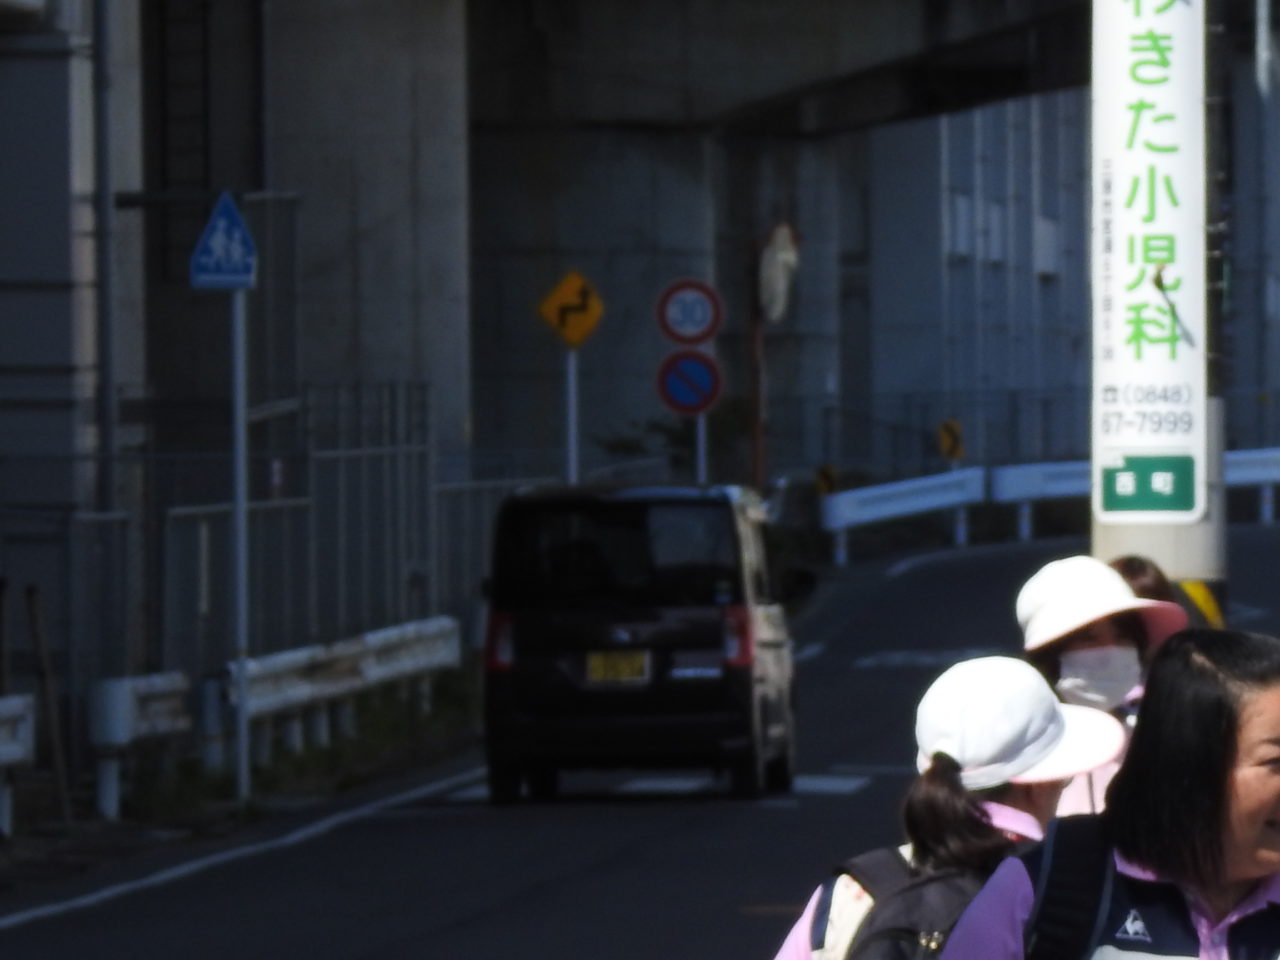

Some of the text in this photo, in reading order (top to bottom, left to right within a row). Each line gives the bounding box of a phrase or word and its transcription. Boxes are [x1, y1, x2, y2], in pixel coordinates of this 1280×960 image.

[1122, 0, 1182, 360] きた小児科
[670, 296, 709, 328] 30
